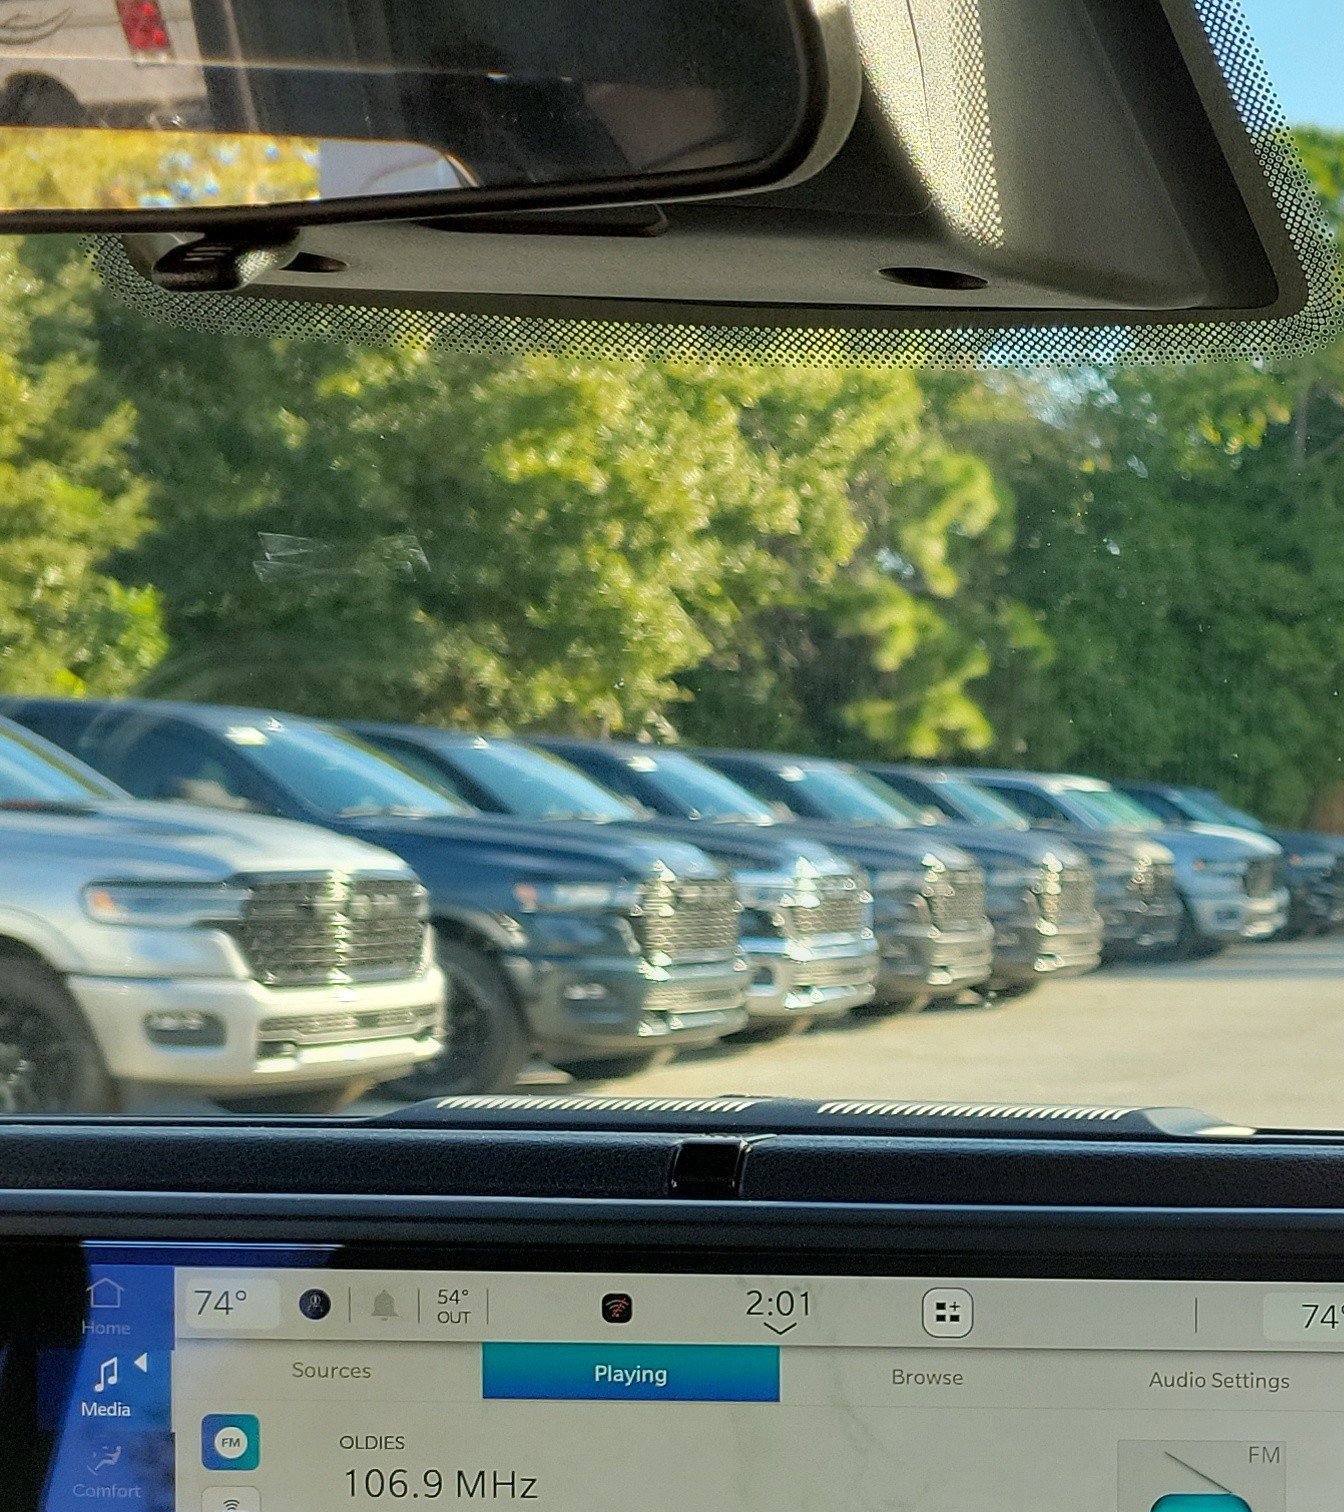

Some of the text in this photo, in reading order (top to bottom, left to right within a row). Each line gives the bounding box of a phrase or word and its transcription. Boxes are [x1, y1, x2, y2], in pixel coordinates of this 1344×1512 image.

[194, 1289, 247, 1316] 74°
[437, 1288, 469, 1306] 54°
[746, 1290, 811, 1317] 2:01
[437, 1310, 471, 1324] OUT
[81, 1319, 130, 1336] Home
[291, 1361, 372, 1380] Sources
[594, 1364, 667, 1386] Playing
[891, 1368, 964, 1386] Browse
[1149, 1372, 1290, 1394] Audio Settings
[81, 1401, 130, 1418] Media
[221, 1438, 240, 1447] FM
[339, 1435, 405, 1450] OLDIES
[1248, 1446, 1280, 1464] FM
[72, 1482, 141, 1500] Comfort
[345, 1468, 538, 1499] 106.9 MHz
